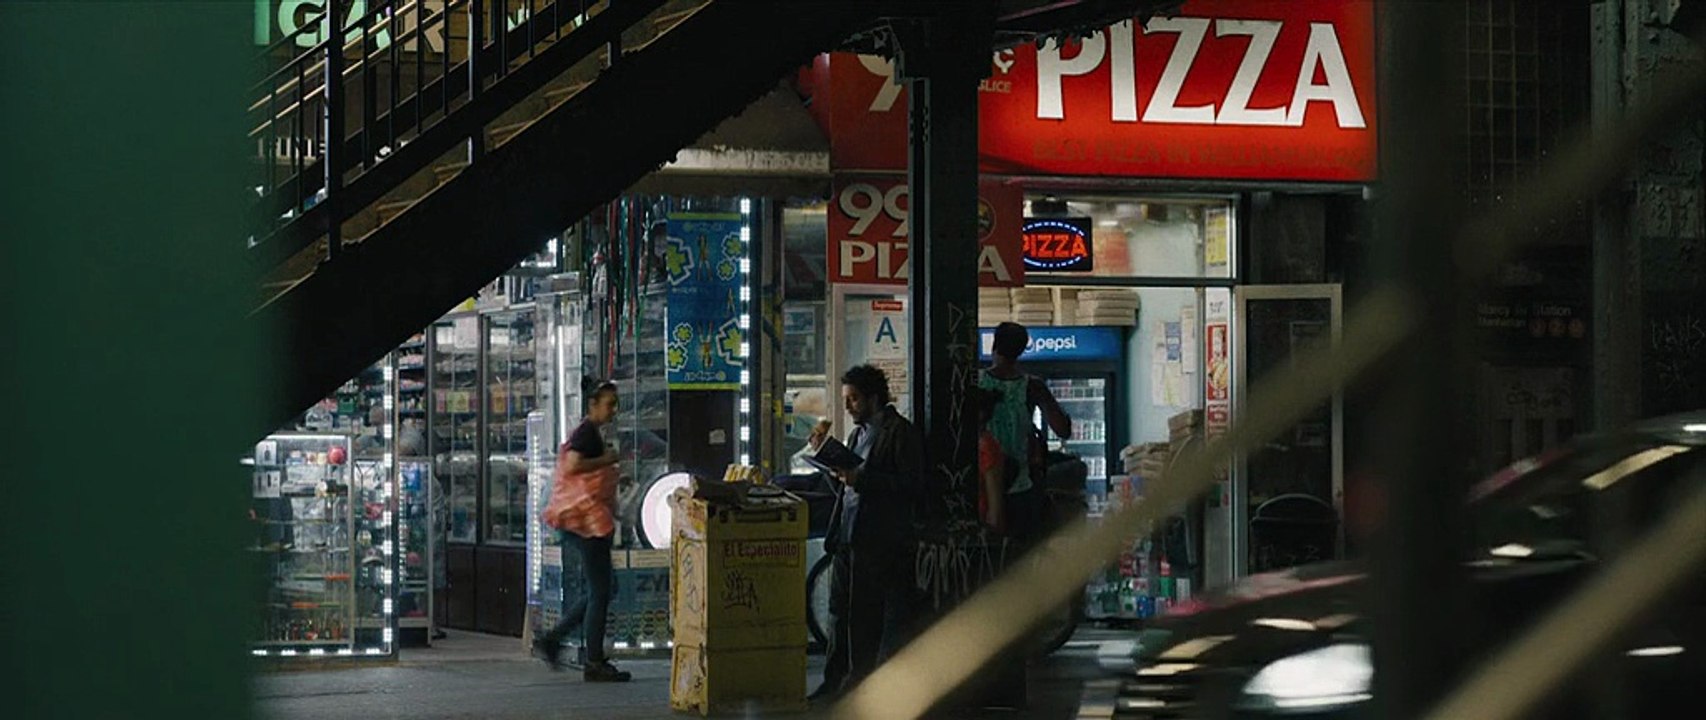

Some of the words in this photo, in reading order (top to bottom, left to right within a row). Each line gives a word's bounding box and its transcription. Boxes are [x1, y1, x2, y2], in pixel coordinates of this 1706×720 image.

[1036, 15, 1367, 128] PIZZA
[840, 239, 1013, 281] PIA
[874, 316, 897, 344] A
[1035, 335, 1076, 352] pepsi
[724, 543, 736, 557] El
